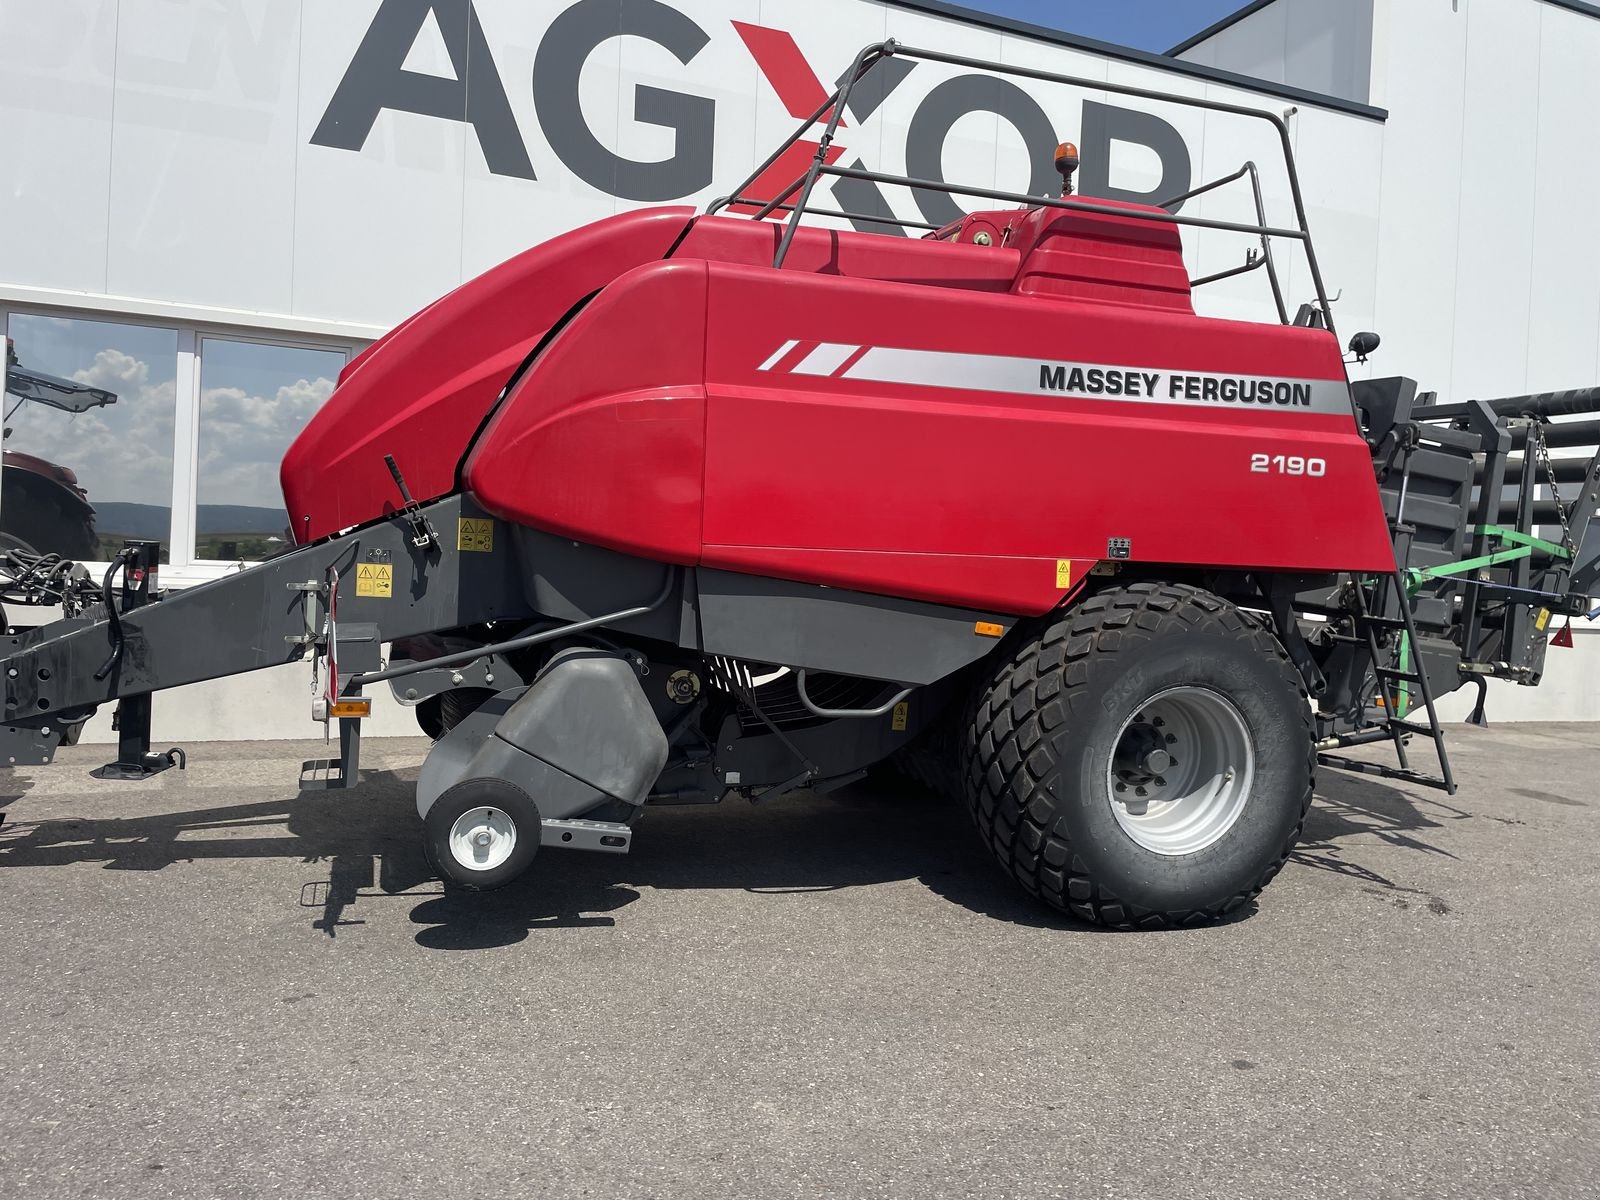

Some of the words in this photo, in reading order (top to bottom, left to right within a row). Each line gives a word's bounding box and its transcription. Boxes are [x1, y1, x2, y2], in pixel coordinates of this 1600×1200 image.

[1039, 364, 1160, 398] MASSEY
[1168, 374, 1311, 406] FERGUSON
[1250, 453, 1326, 477] 2190
